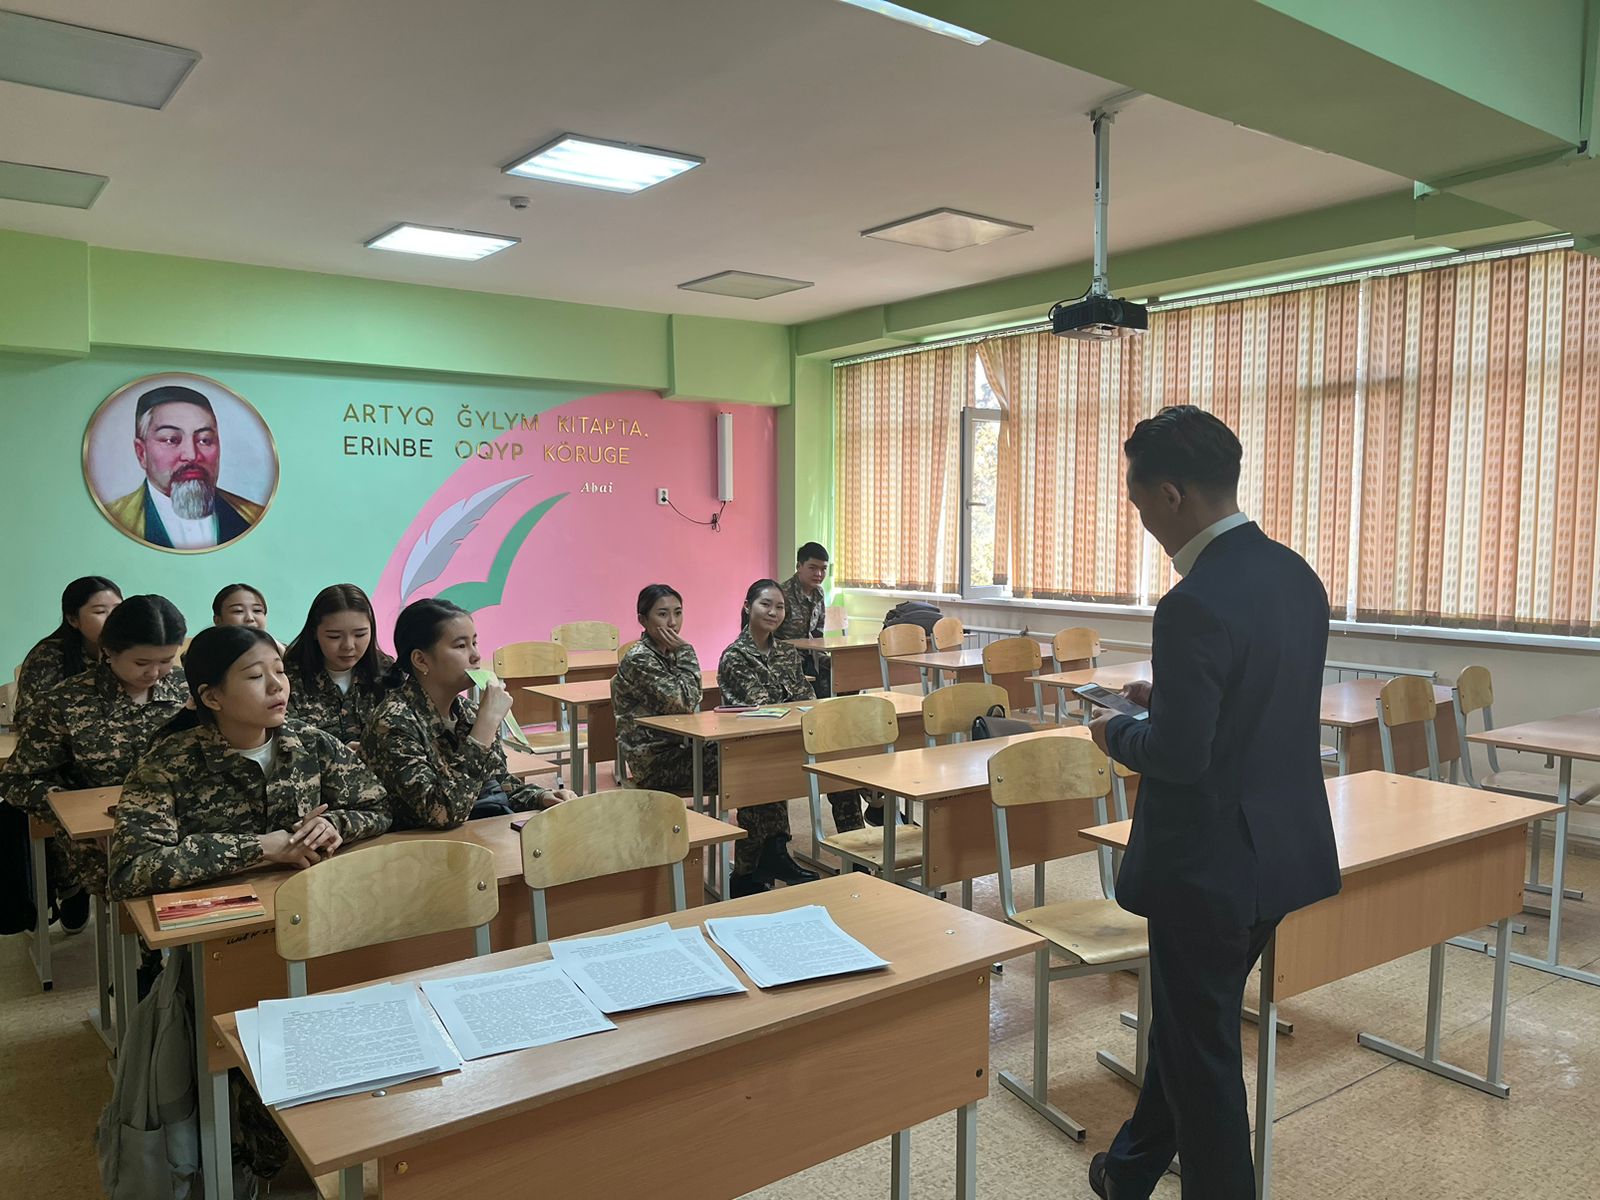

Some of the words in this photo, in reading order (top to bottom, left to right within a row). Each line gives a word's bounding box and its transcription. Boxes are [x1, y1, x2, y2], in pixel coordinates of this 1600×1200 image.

[343, 403, 434, 427] ARTYQ
[457, 403, 539, 431] ĞYLYM
[344, 435, 433, 458] ERINBE
[455, 440, 524, 461] OQYP
[543, 441, 631, 465] KÖRUGE
[580, 481, 613, 493] Abai
